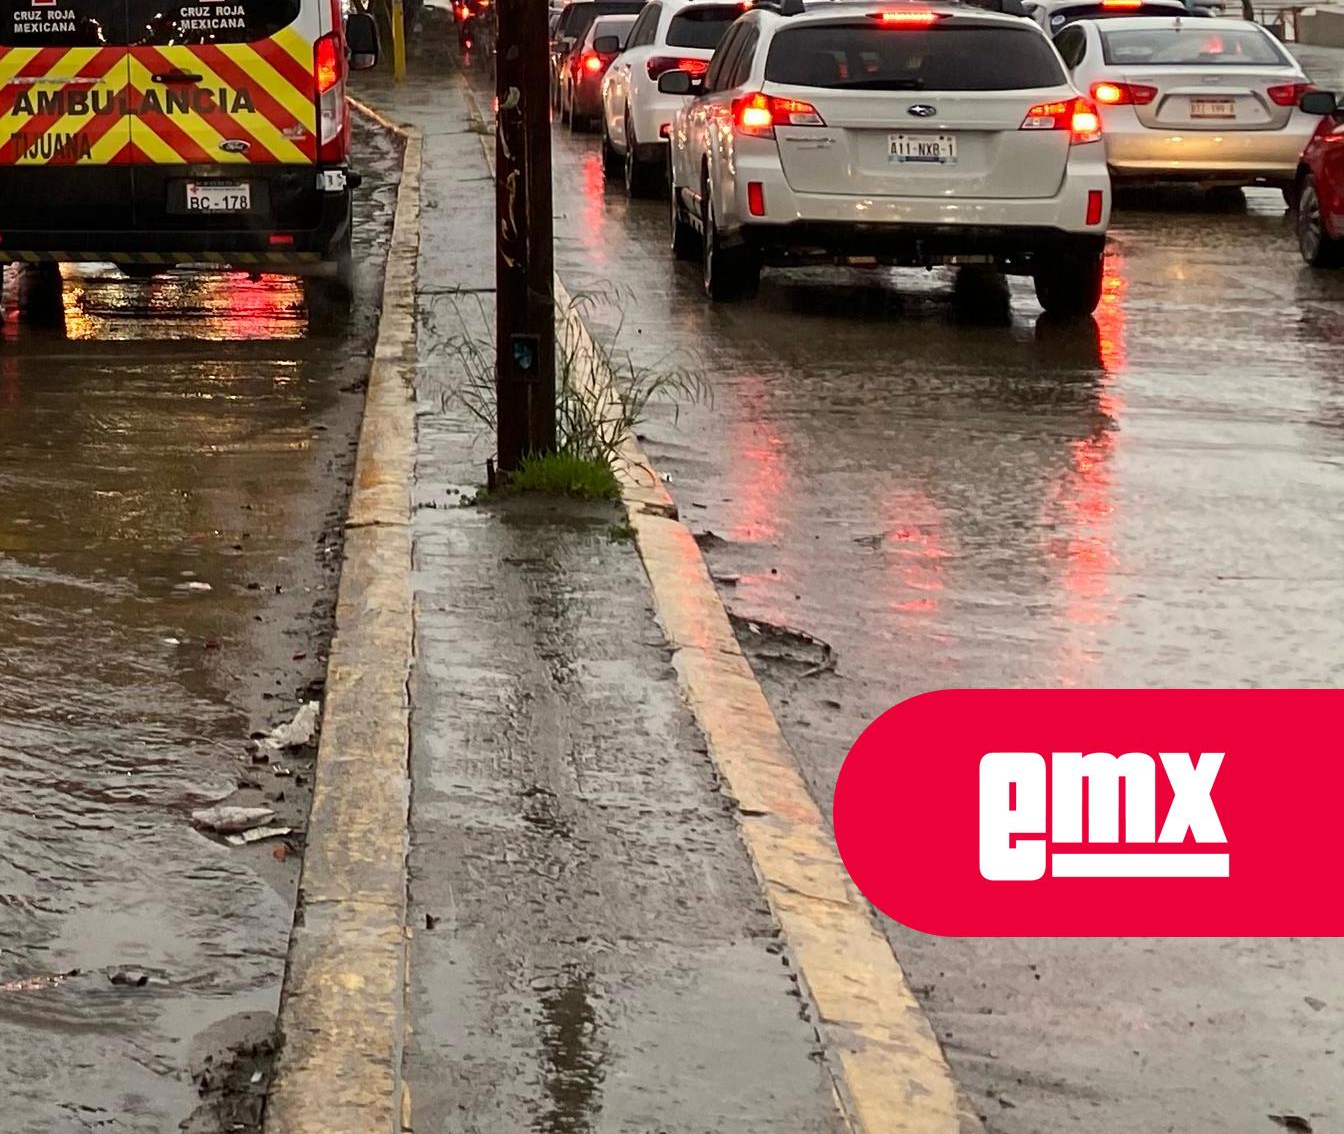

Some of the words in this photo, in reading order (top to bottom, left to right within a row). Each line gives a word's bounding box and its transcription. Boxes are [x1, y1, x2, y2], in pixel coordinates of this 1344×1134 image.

[14, 10, 42, 21] CRUZ
[47, 9, 76, 20] ROJA
[180, 6, 210, 17] CRUZ
[216, 5, 246, 16] ROJA
[14, 21, 76, 34] MEXICANA
[180, 18, 246, 30] MEXICANA
[11, 87, 257, 116] AMBULANCIA
[11, 132, 92, 160] TIJUANA
